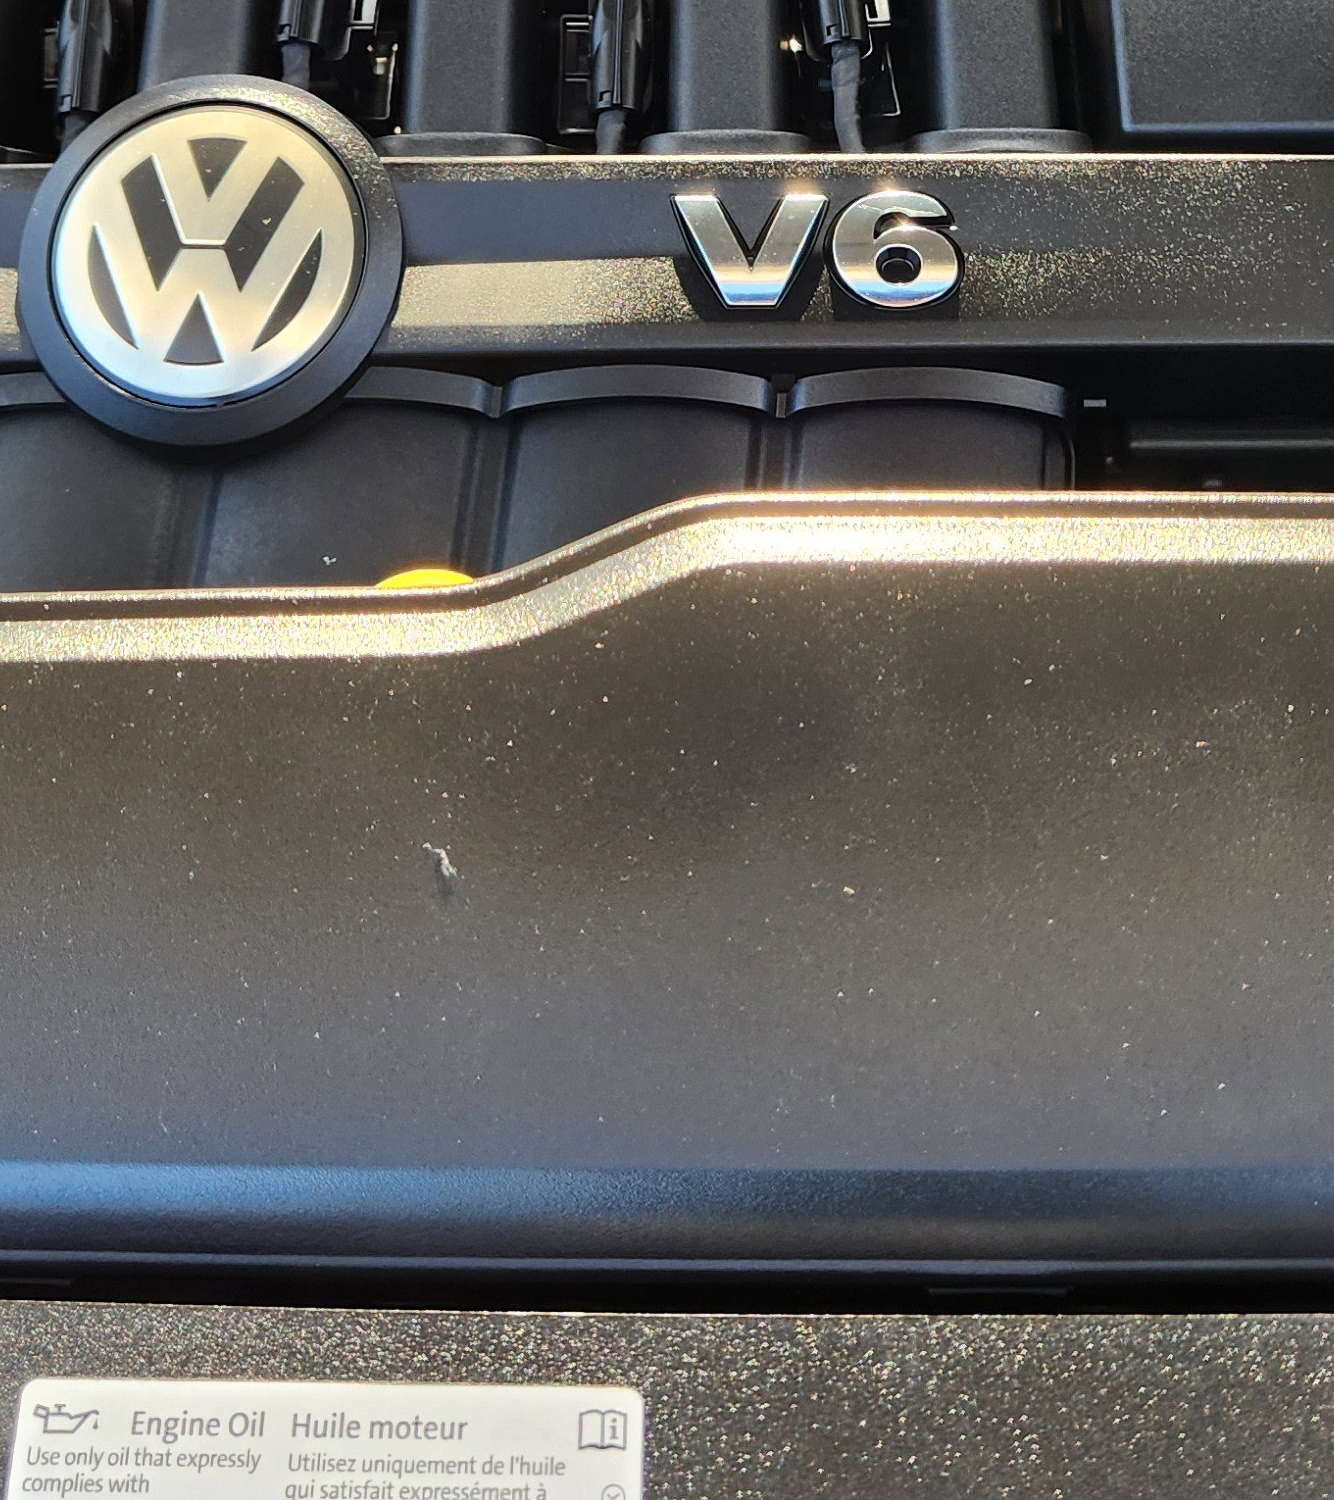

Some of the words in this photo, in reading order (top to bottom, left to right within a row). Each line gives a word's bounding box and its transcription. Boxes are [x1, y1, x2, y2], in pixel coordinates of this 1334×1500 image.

[669, 190, 966, 310] V6
[131, 1409, 221, 1444] Engine
[228, 1410, 266, 1437] Oil
[291, 1411, 361, 1439] Huile
[369, 1414, 468, 1441] moteur
[26, 1446, 63, 1467] Use
[65, 1447, 104, 1472] only
[108, 1447, 130, 1467] oil
[134, 1447, 172, 1467] that
[176, 1449, 262, 1474] expressly
[287, 1453, 357, 1474] Utilisez
[361, 1454, 476, 1479] uniquement
[481, 1455, 505, 1476] de
[509, 1456, 567, 1477] l'huile
[22, 1473, 103, 1499] complies
[108, 1473, 150, 1494] with
[285, 1480, 315, 1500] qui
[320, 1479, 394, 1500] satisfait
[399, 1480, 531, 1500] expressément
[536, 1481, 547, 1500] à
